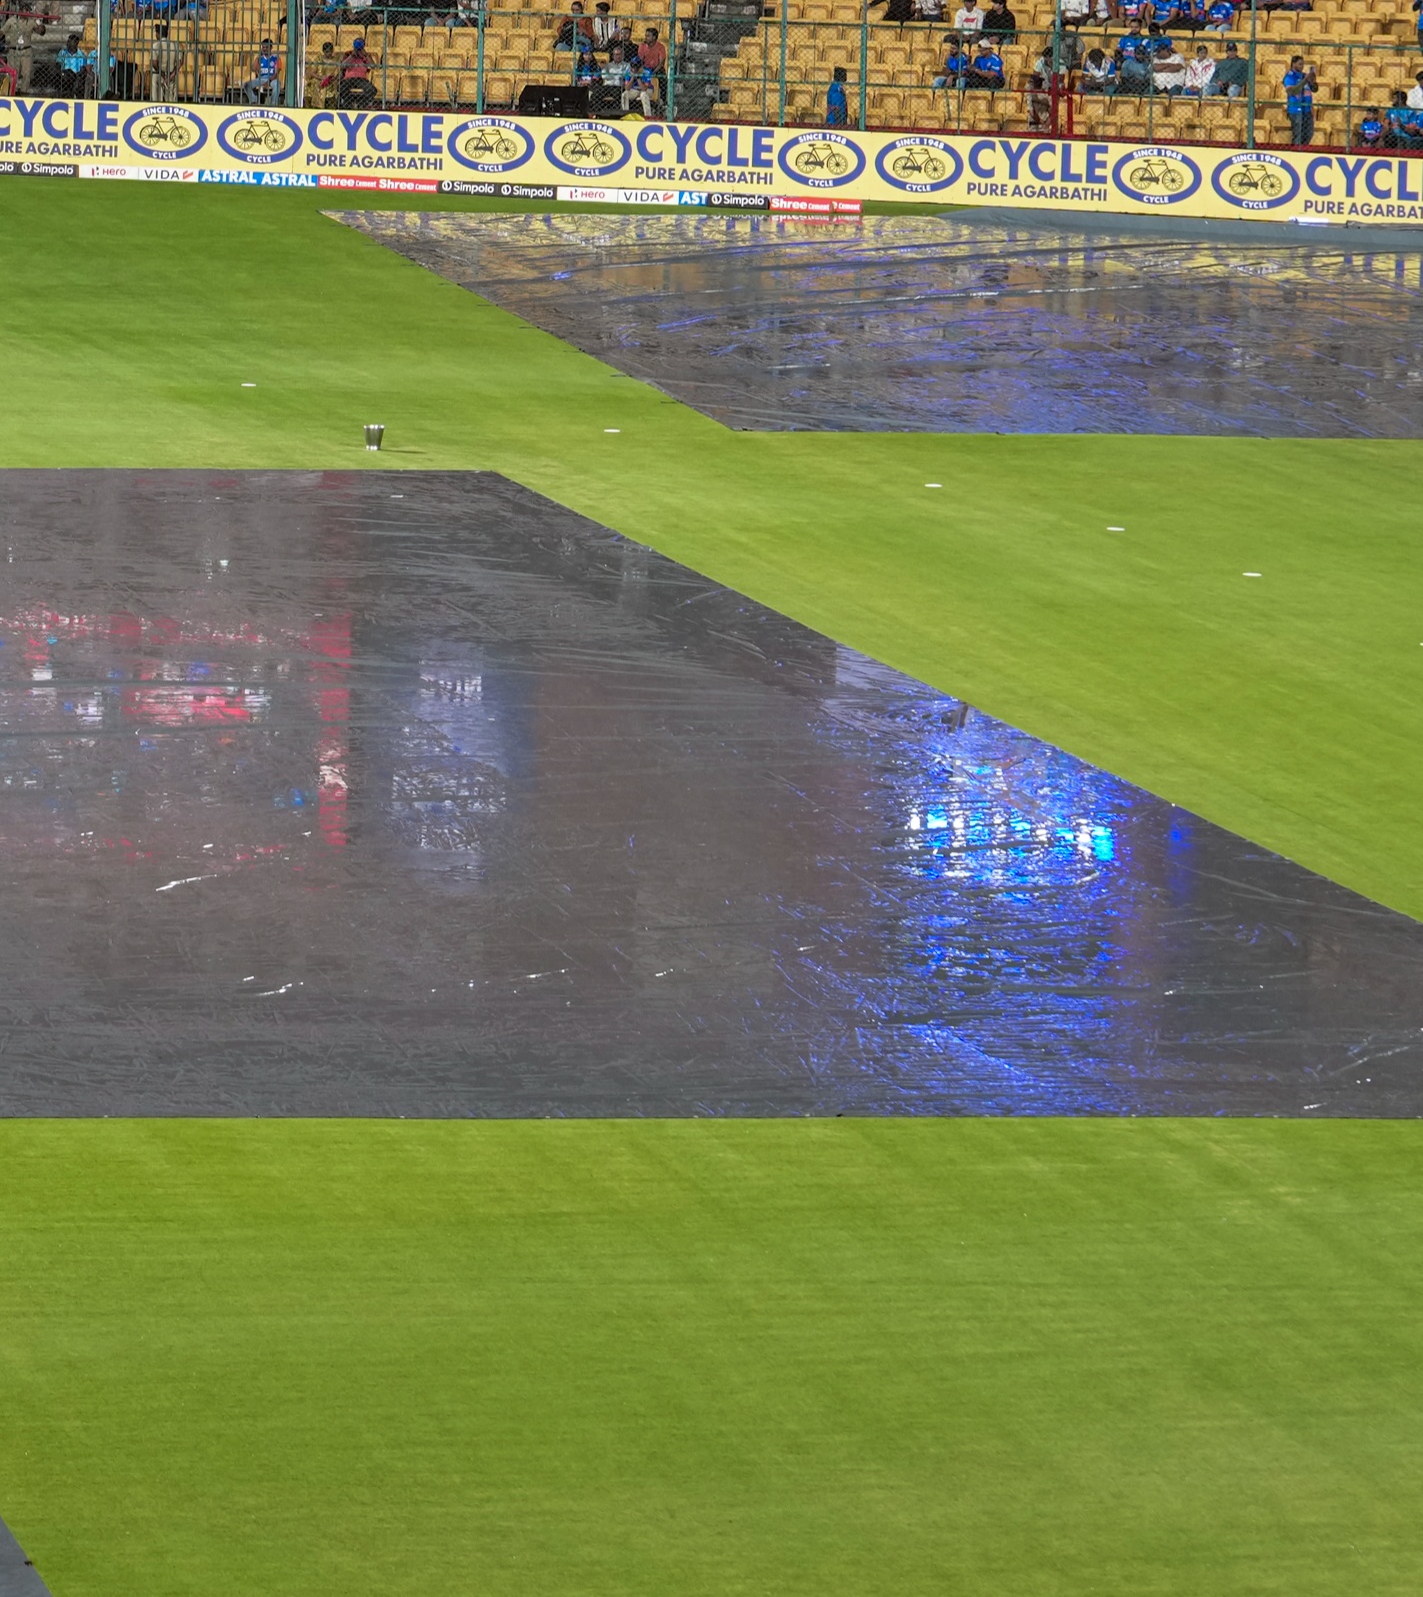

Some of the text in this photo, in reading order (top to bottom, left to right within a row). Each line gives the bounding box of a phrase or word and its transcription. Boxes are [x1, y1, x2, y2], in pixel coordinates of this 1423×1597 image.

[798, 133, 847, 145] SINCE 1948
[637, 124, 774, 168] CYCLE
[349, 155, 443, 171] AGARBATHI
[202, 170, 257, 184] ASTRAL
[636, 166, 675, 180] PURE
[808, 178, 834, 187] CYCLE
[623, 191, 660, 202] VIDA
[681, 191, 707, 204] AST
[723, 194, 764, 206] Simpolo
[1011, 185, 1107, 202] AGARBATHI
[771, 198, 807, 210] Shree
[1304, 200, 1344, 214] PURE
